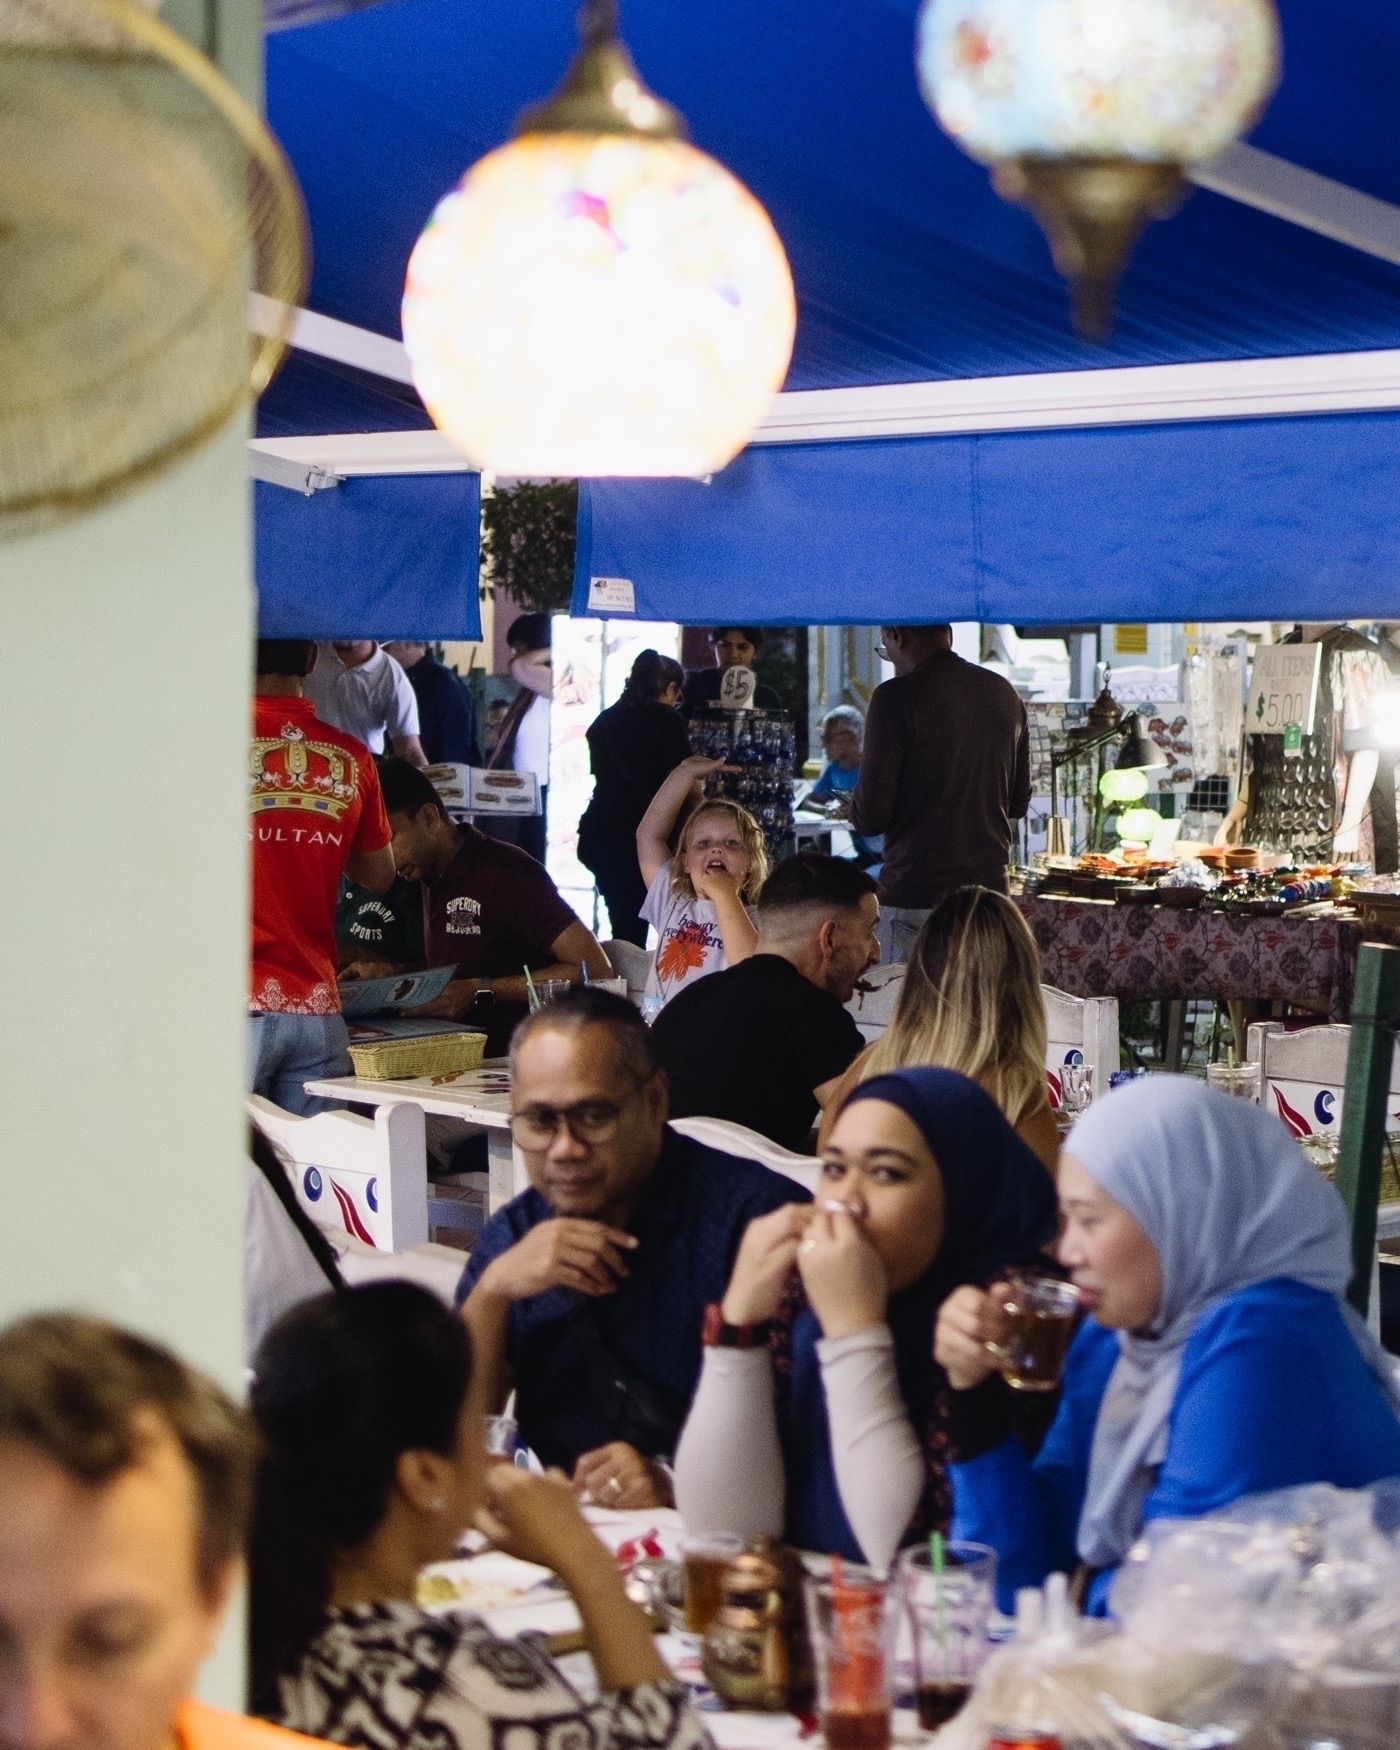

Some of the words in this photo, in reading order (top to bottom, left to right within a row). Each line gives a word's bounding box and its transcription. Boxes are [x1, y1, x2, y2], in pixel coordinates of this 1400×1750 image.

[723, 670, 750, 700] $5
[358, 901, 396, 923] SUPERDRY
[446, 896, 482, 917] SUPERDRY
[349, 921, 383, 941] SPORTS
[677, 913, 719, 936] beauty
